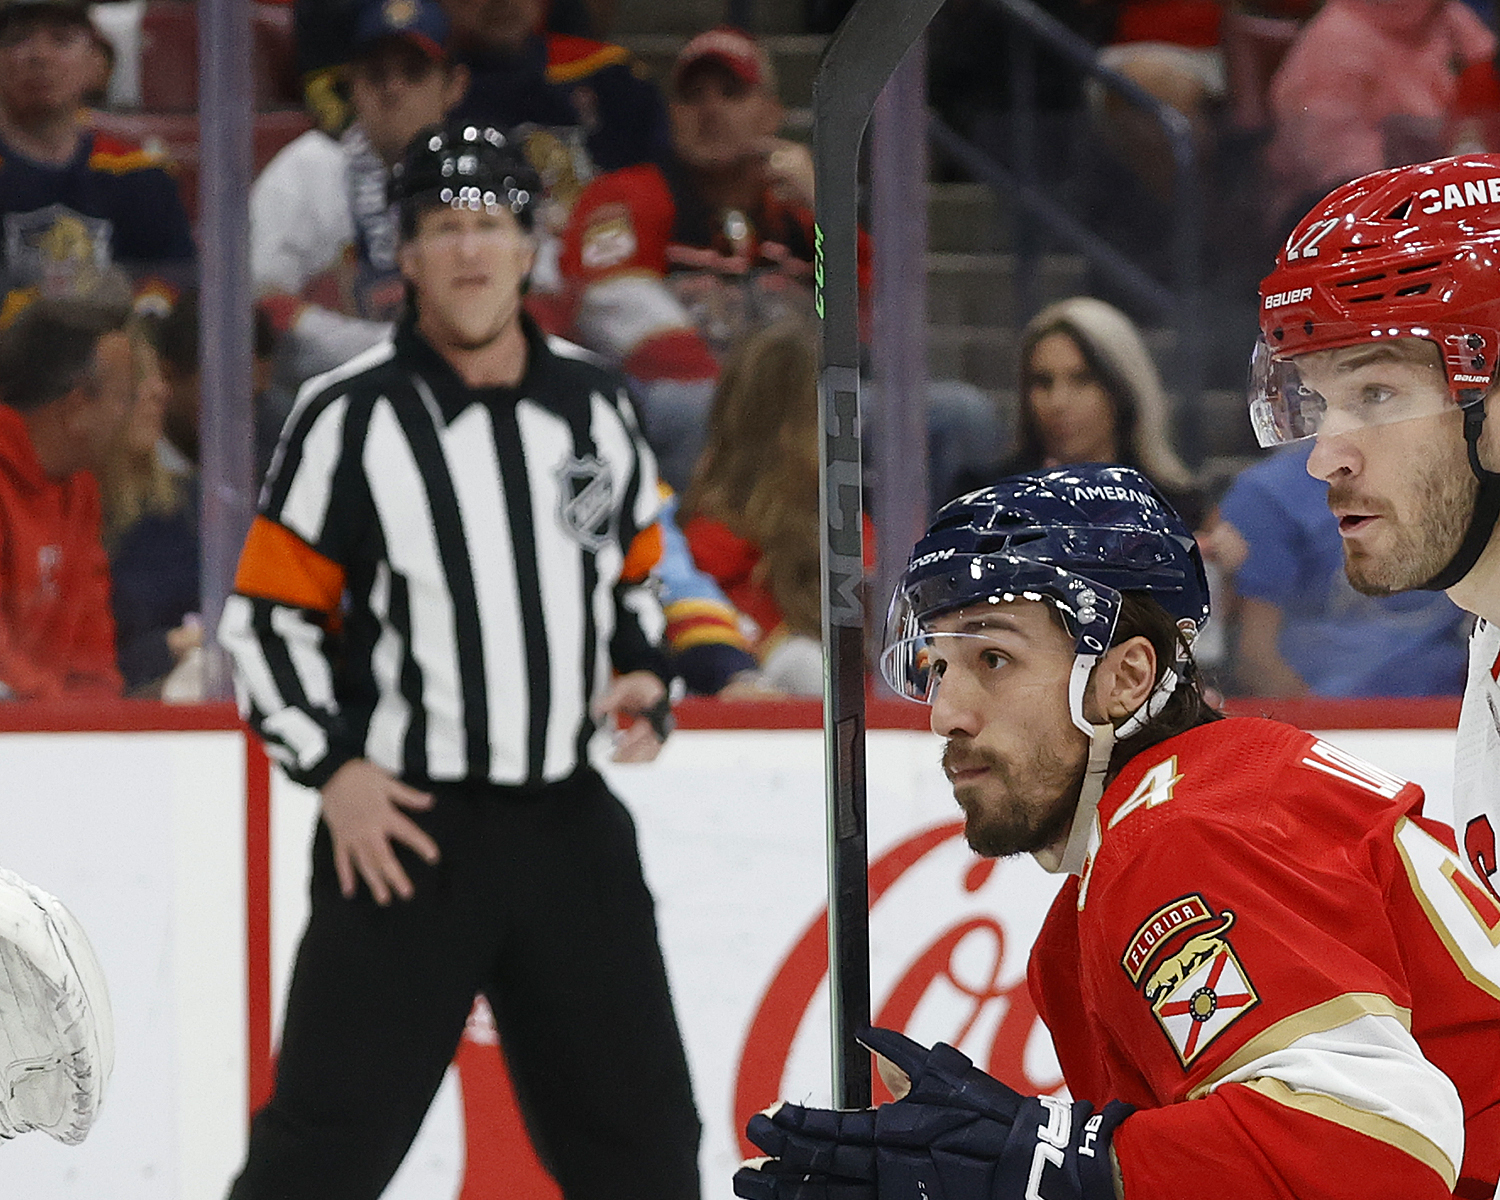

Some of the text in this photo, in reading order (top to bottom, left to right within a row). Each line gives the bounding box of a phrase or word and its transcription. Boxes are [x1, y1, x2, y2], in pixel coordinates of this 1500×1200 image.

[1286, 217, 1341, 262] 22
[815, 222, 826, 321] CCM
[1073, 485, 1161, 511] AMERANT
[1129, 903, 1196, 966] FLORIDA
